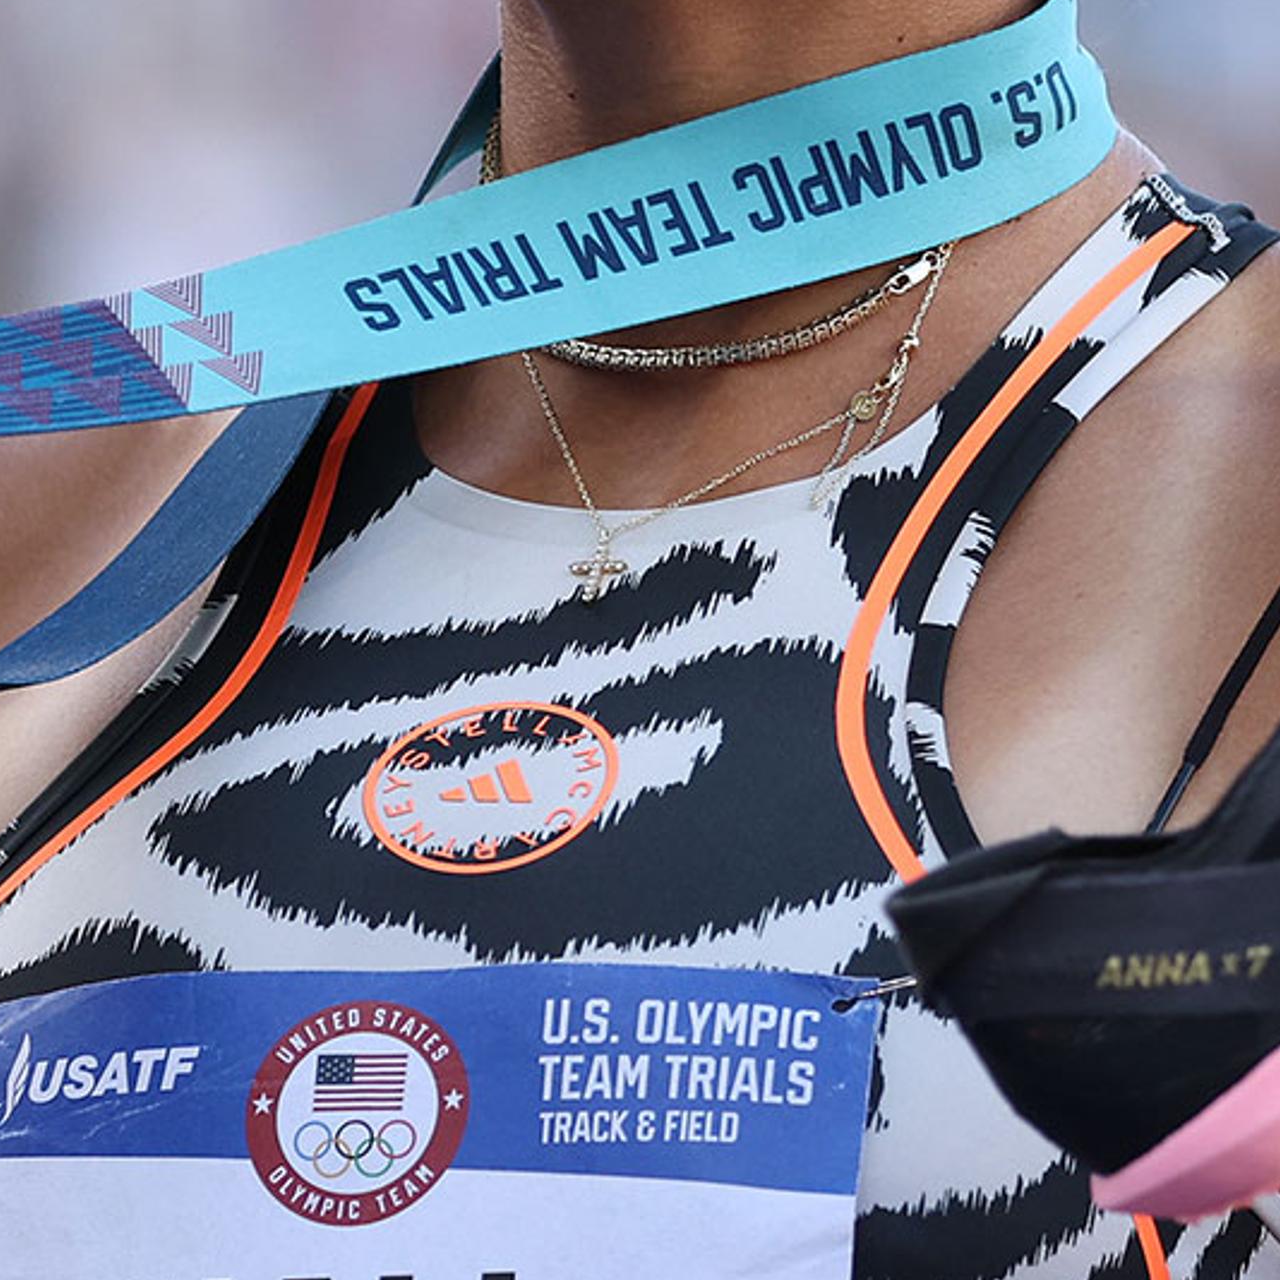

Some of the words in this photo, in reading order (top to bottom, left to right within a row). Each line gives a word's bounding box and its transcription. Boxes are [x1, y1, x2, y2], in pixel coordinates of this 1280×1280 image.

[989, 60, 1078, 149] U.S.
[733, 101, 984, 234] OLYMPIC
[557, 180, 735, 280] TEAM
[343, 231, 563, 332] TRIALS
[400, 711, 587, 768] STELLA
[1095, 951, 1212, 988] ANNA
[1245, 944, 1273, 980] 7
[275, 1007, 361, 1065] UNITED
[372, 1007, 450, 1062] STATES
[542, 997, 619, 1045] U.S.
[635, 998, 822, 1052] OLYMPIC
[27, 1045, 201, 1104] USATF
[538, 1053, 651, 1102] TEAM
[665, 1055, 817, 1106] TRIALS
[538, 1110, 630, 1145] TRACK
[636, 1109, 657, 1142] &
[663, 1110, 740, 1143] FIELD
[268, 1165, 361, 1220] OLYMPIC
[375, 1163, 436, 1214] TEAM
